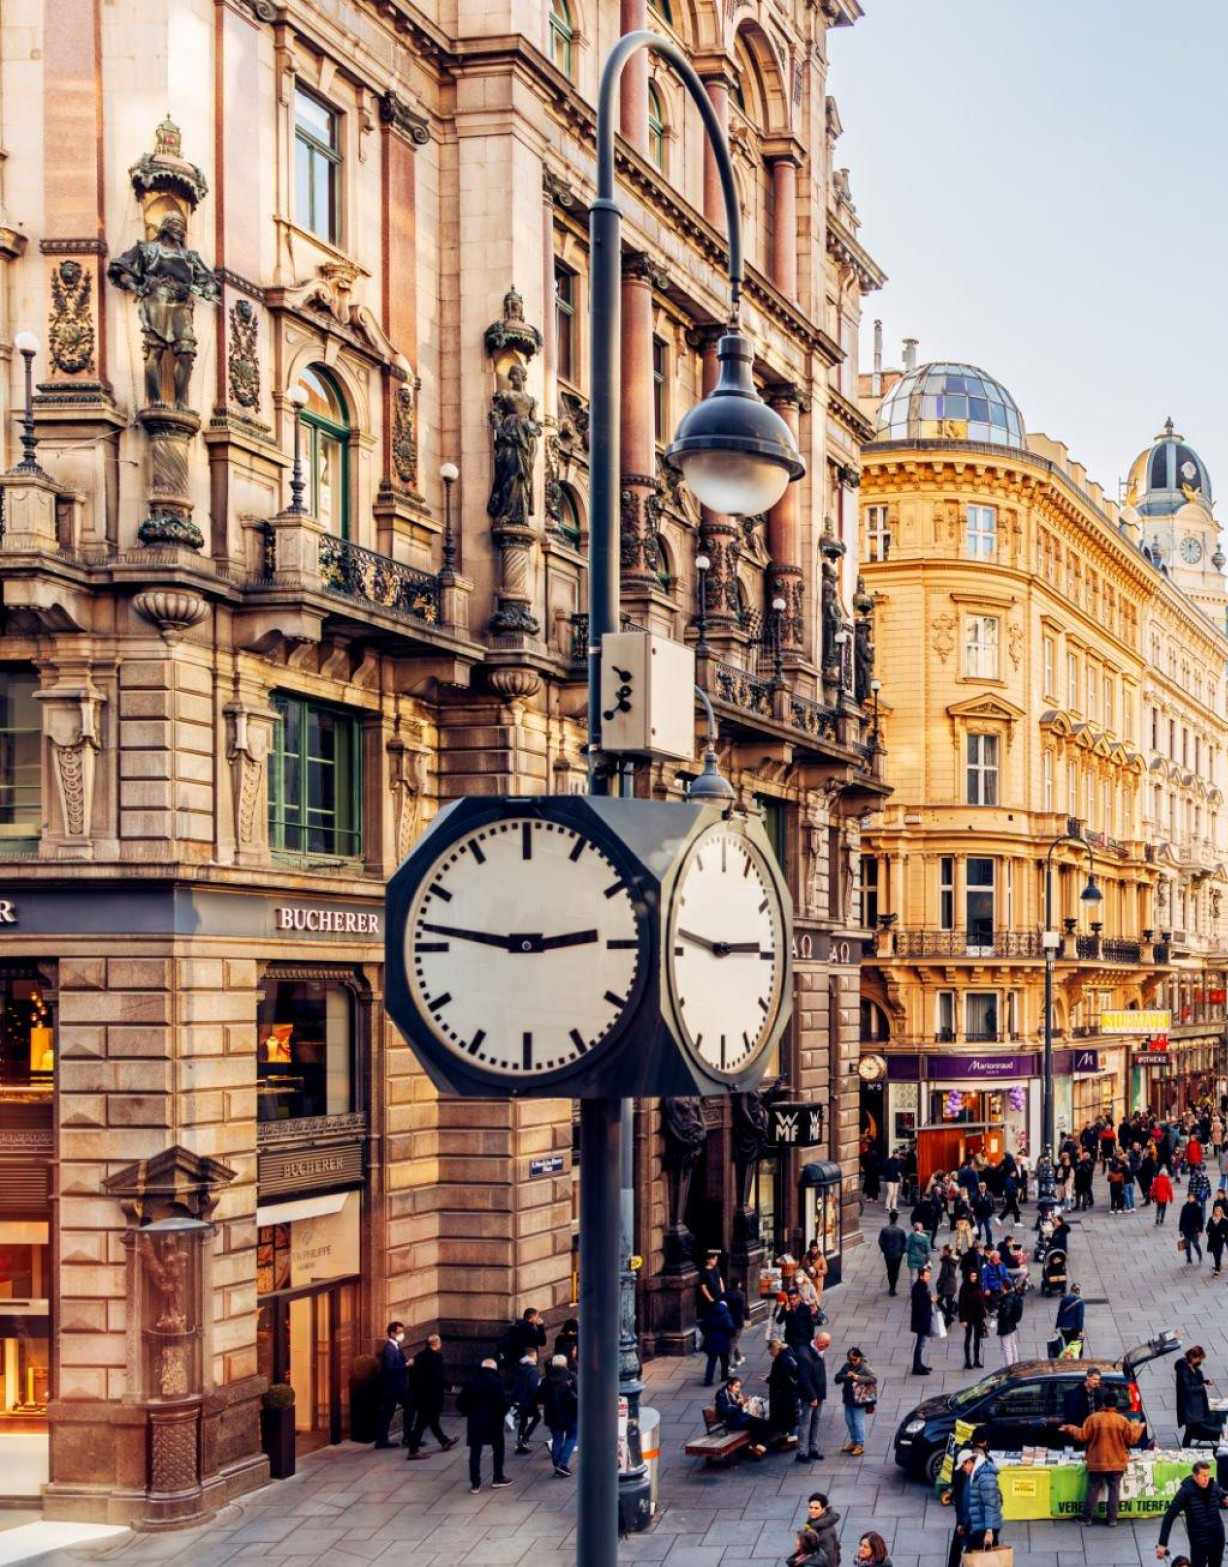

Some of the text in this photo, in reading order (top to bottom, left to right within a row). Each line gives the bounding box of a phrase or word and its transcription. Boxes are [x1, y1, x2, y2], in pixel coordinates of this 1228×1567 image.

[280, 907, 380, 934] BUCHERER
[968, 1060, 1013, 1072] Marionnaud
[283, 1157, 344, 1178] BUCHERER
